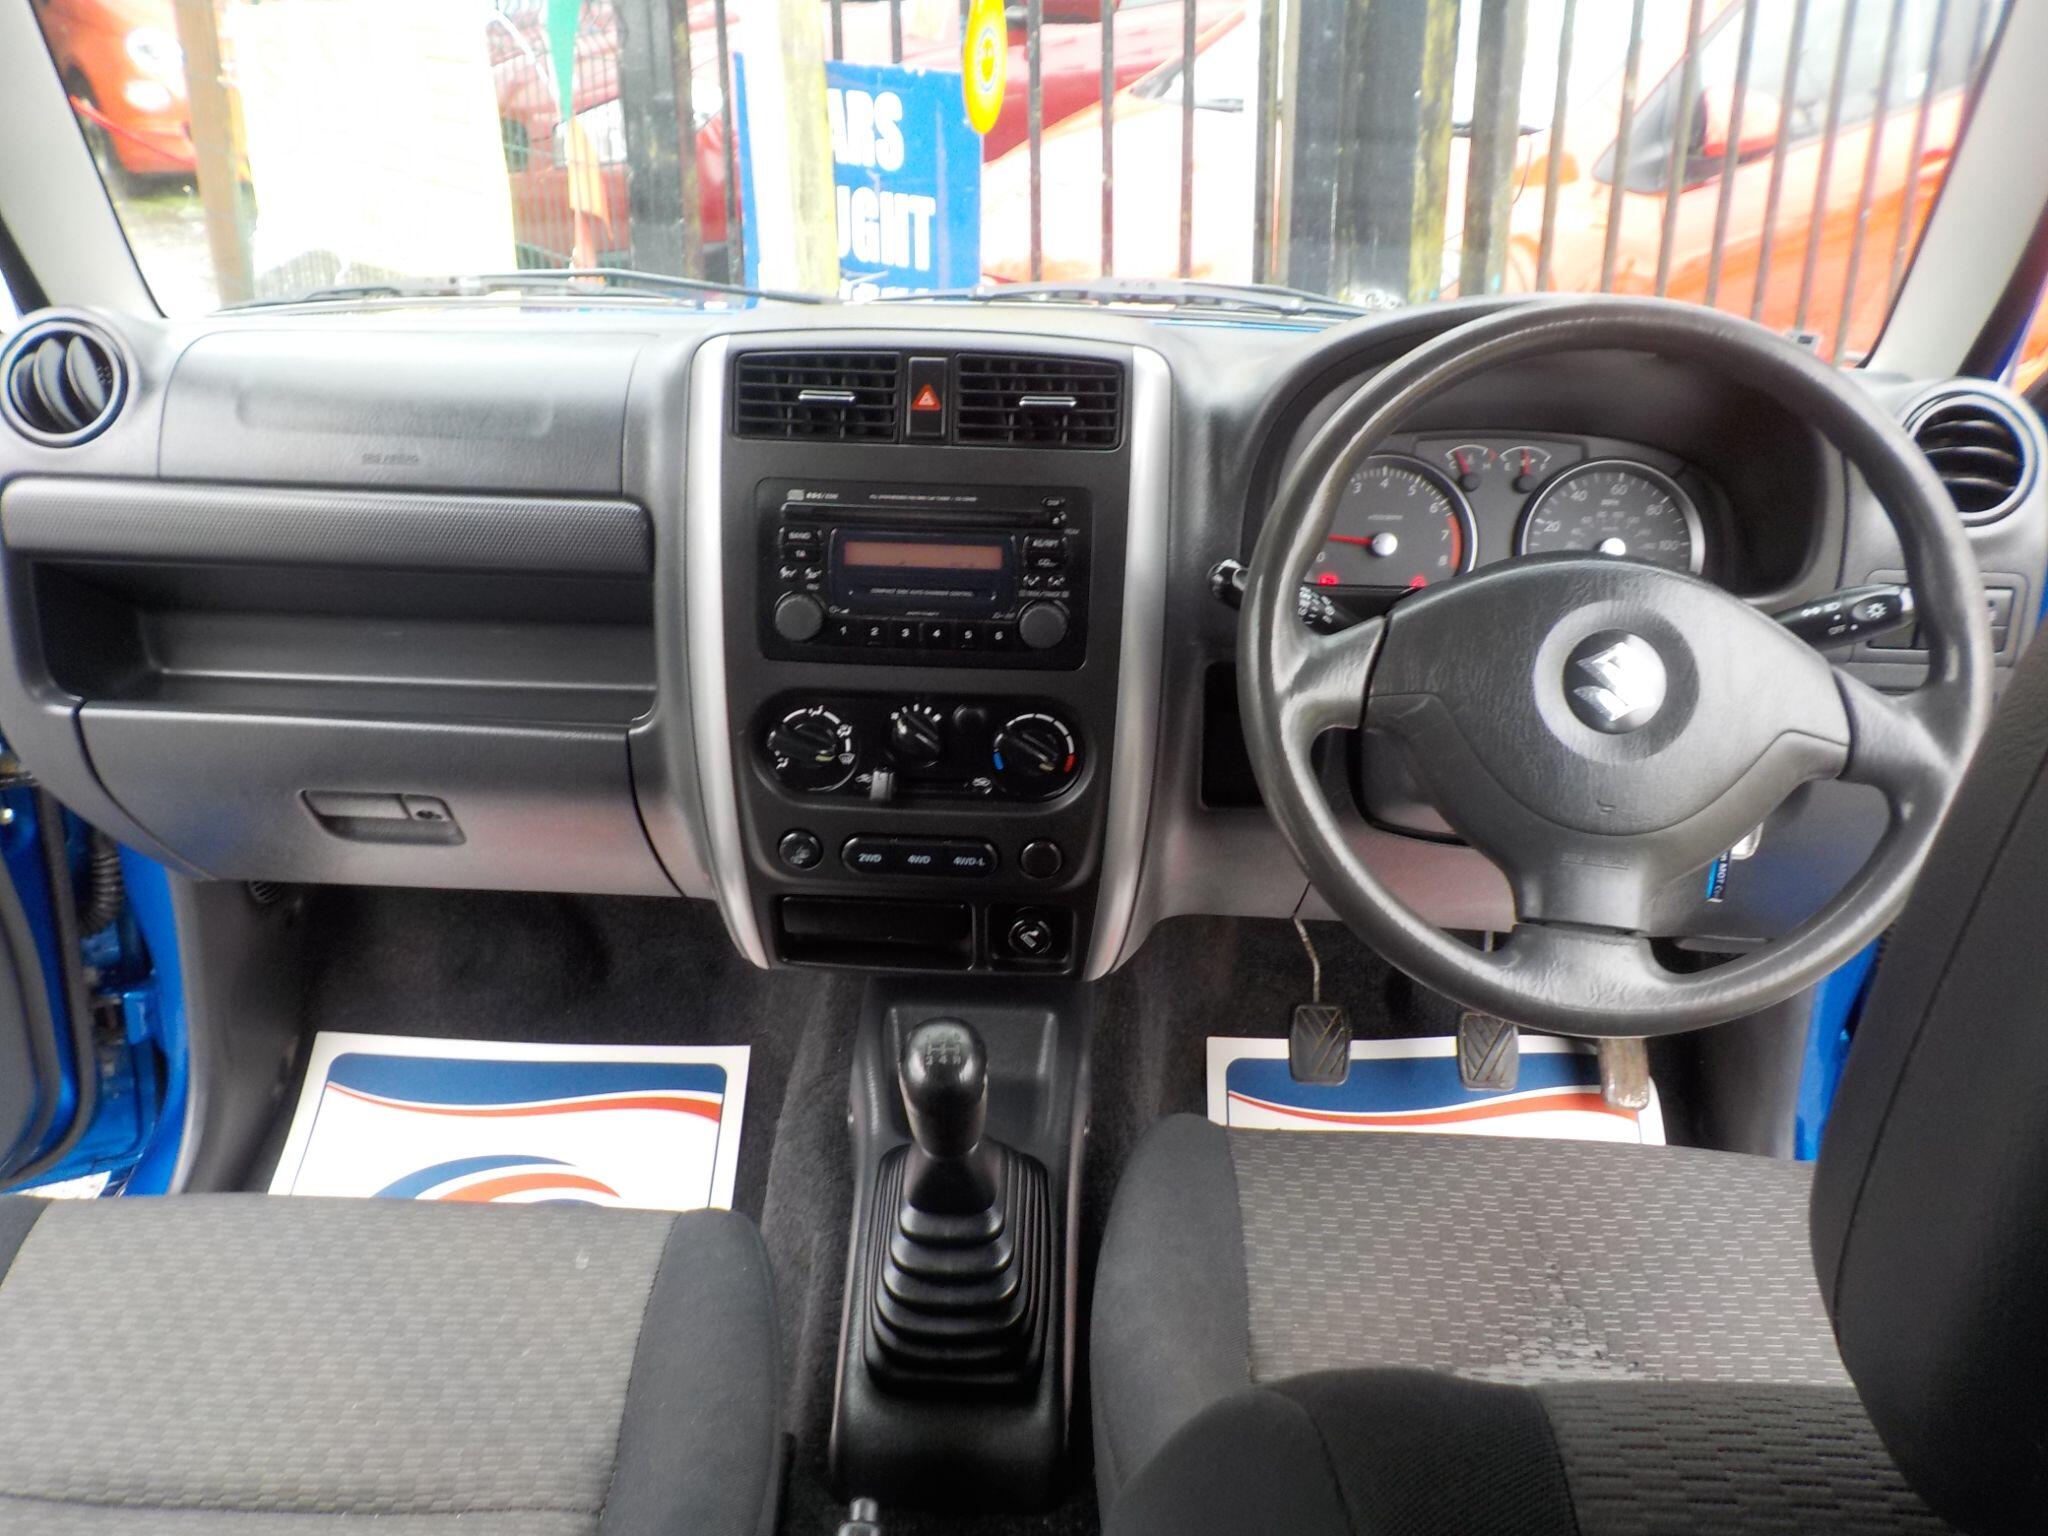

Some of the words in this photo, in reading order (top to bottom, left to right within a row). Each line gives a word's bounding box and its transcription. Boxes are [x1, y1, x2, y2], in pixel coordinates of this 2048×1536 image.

[827, 88, 905, 171] ARS
[1353, 482, 1362, 494] 3
[1380, 477, 1390, 488] 4
[1408, 484, 1417, 496] 5
[1570, 489, 1588, 501] 40
[1610, 484, 1628, 496] 60
[1429, 503, 1439, 514] 6
[1645, 503, 1663, 516] 80
[1543, 520, 1561, 533] 20
[1441, 530, 1450, 541] 7
[1658, 539, 1680, 551] 100
[1316, 552, 1326, 563] 0
[1438, 554, 1448, 566] 8
[870, 627, 879, 637] 2
[901, 628, 910, 638] 3
[932, 629, 941, 638] 4
[859, 853, 882, 863] 2WD
[907, 855, 931, 864] 4WD
[1717, 863, 1728, 884] MOT
